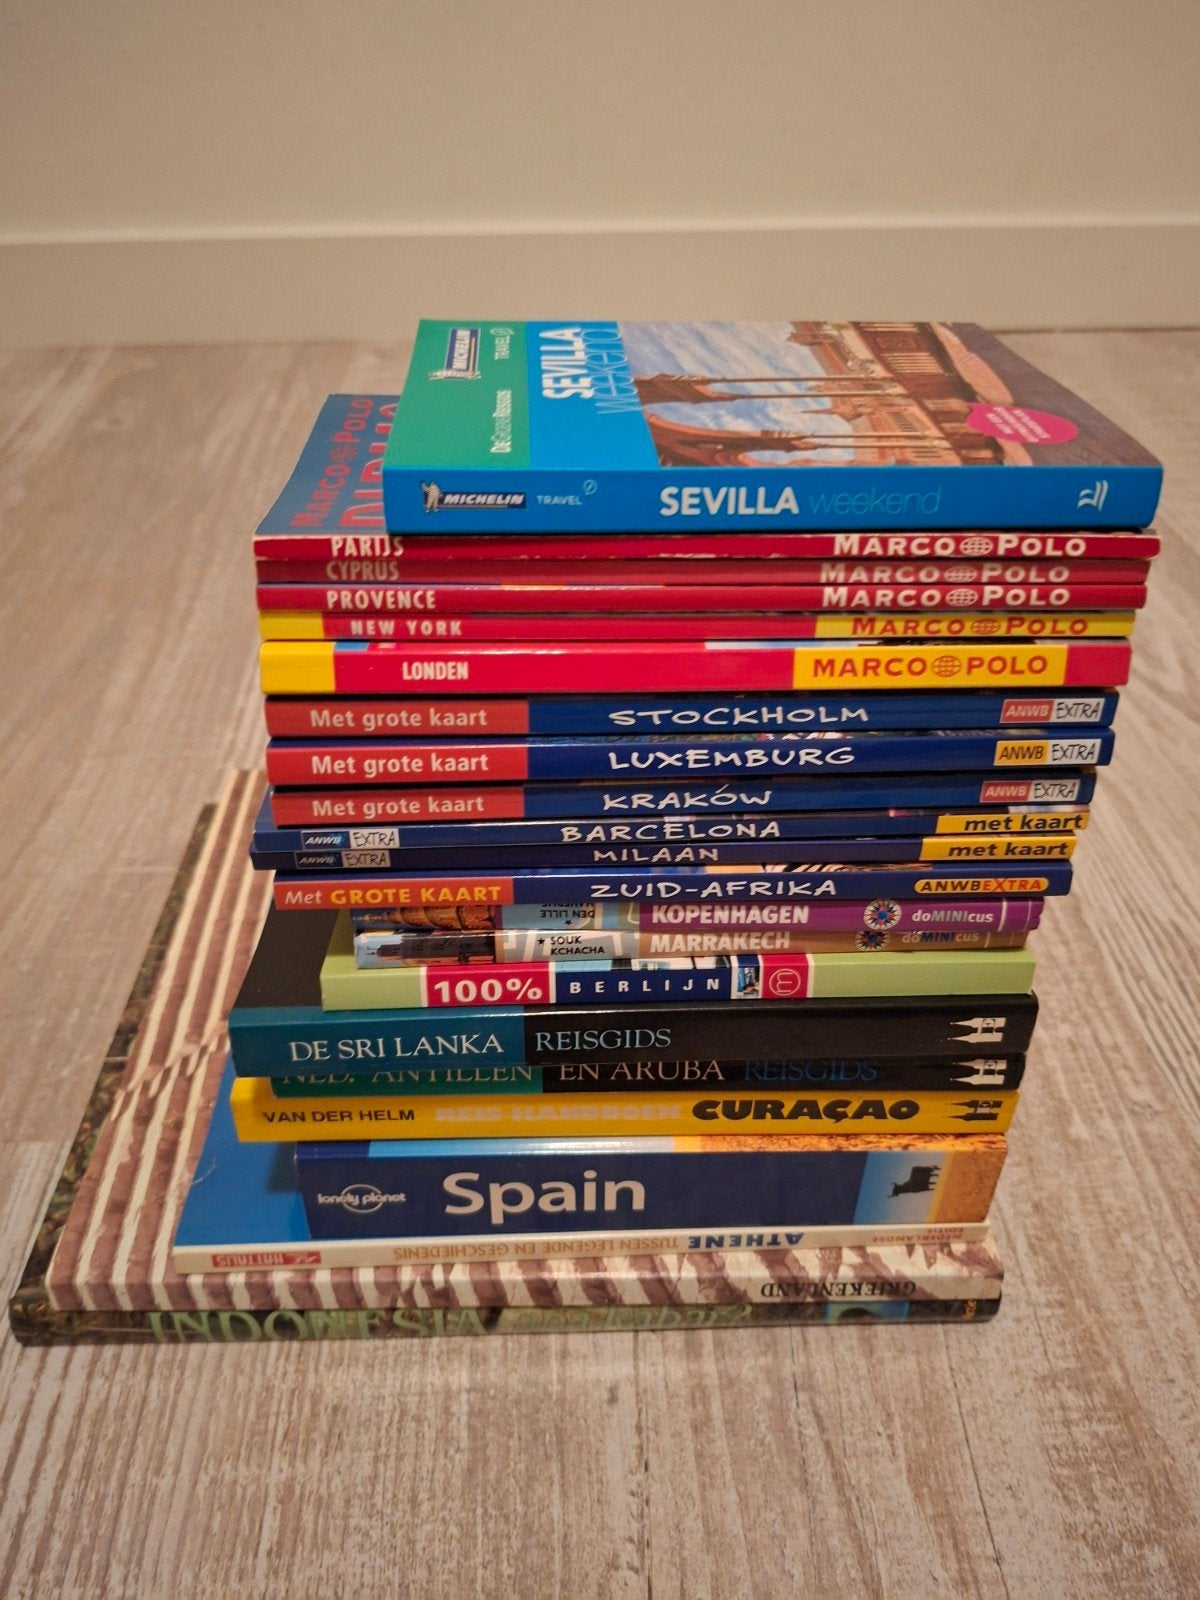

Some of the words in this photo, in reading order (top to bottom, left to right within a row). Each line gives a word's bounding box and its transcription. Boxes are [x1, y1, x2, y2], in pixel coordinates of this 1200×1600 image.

[494, 335, 510, 360] TRAVEL
[539, 327, 594, 399] SEVILLA
[580, 328, 642, 414] weekend
[289, 464, 351, 526] MARCO
[332, 398, 374, 443] POLO
[443, 494, 525, 506] MICHELIN
[536, 495, 582, 506] TRAVEL
[659, 486, 799, 516] SEVILLA
[809, 486, 942, 514] weekend
[330, 535, 405, 557] PARIJS
[833, 535, 955, 557] MARCO
[997, 535, 1087, 557] POLO
[326, 561, 400, 581] CYPRUS
[820, 564, 940, 583] MARCO
[980, 564, 1070, 583] POLO
[326, 590, 436, 610] PROVENCE
[822, 586, 942, 608] MARCO
[982, 586, 1071, 608] POLO
[351, 620, 395, 636] NEW
[406, 620, 463, 636] YORK
[852, 617, 966, 636] MARCO
[1005, 617, 1089, 636] POLO
[402, 661, 469, 681] LONDEN
[813, 657, 928, 678] MARCO
[966, 655, 1049, 676] POLO
[310, 710, 354, 728] Met
[363, 710, 422, 732] grote
[430, 707, 488, 726] kaart
[608, 706, 869, 726] STOCKHOLM
[1005, 704, 1049, 717] ANWB
[1056, 701, 1100, 720] EXTRA
[609, 747, 855, 770] LUXEMBURG
[999, 747, 1044, 760] ANWB
[1051, 743, 1096, 762] EXTRA
[311, 756, 355, 775] Met
[364, 756, 423, 778] grote
[431, 753, 489, 773] kaart
[603, 784, 772, 811] KRAKÓW
[984, 785, 1027, 797] ANWB
[1033, 781, 1077, 800] EXTRA
[312, 800, 355, 817] Met
[363, 799, 421, 819] grote
[428, 796, 485, 813] kaart
[561, 821, 781, 843] BARCELONA
[964, 817, 1011, 831] met
[1020, 814, 1083, 830] kaart
[305, 834, 342, 846] ANWB
[352, 832, 395, 847] EXTRA
[948, 842, 997, 857] met
[1004, 841, 1069, 857] kaart
[345, 852, 388, 866] EXTRA
[593, 847, 719, 863] MILAAN
[285, 890, 322, 905] Met
[330, 888, 410, 906] GROTE
[421, 886, 501, 904] KAART
[591, 879, 837, 898] ZUID-AFRIKA
[540, 909, 568, 918] LILLE
[573, 909, 596, 918] DEN
[651, 905, 809, 924] KOPENHAGEN
[911, 910, 994, 923] doMINIcus
[551, 936, 582, 945] SOUK
[551, 946, 605, 955] KCHACHA
[650, 931, 790, 953] MARRAKECH
[434, 978, 542, 1002] 100%
[290, 1041, 332, 1061] DE
[338, 1038, 387, 1060] SRI
[396, 1034, 504, 1056] LANKA
[534, 1028, 672, 1051] REISGIDS
[559, 1063, 599, 1081] EN
[611, 1060, 725, 1080] ARUBA
[744, 1060, 877, 1080] REISGIDS
[263, 1111, 309, 1123] VAN
[311, 1111, 352, 1123] DER
[359, 1109, 415, 1122] HELM
[692, 1099, 920, 1124] CURAÇAO
[318, 1192, 358, 1205] lonely
[362, 1191, 406, 1204] planet
[443, 1170, 646, 1225] Spain
[688, 1232, 804, 1250] ATHENE
[872, 1232, 963, 1243] NEDERLANDSE
[395, 1243, 508, 1260] GESCHIEDENIS
[514, 1242, 536, 1254] EN
[542, 1239, 614, 1254] LEGENDE
[620, 1237, 679, 1250] TUSSEN
[761, 1281, 916, 1298] GRIEKENLAND
[148, 1309, 488, 1343] INDONESIA
